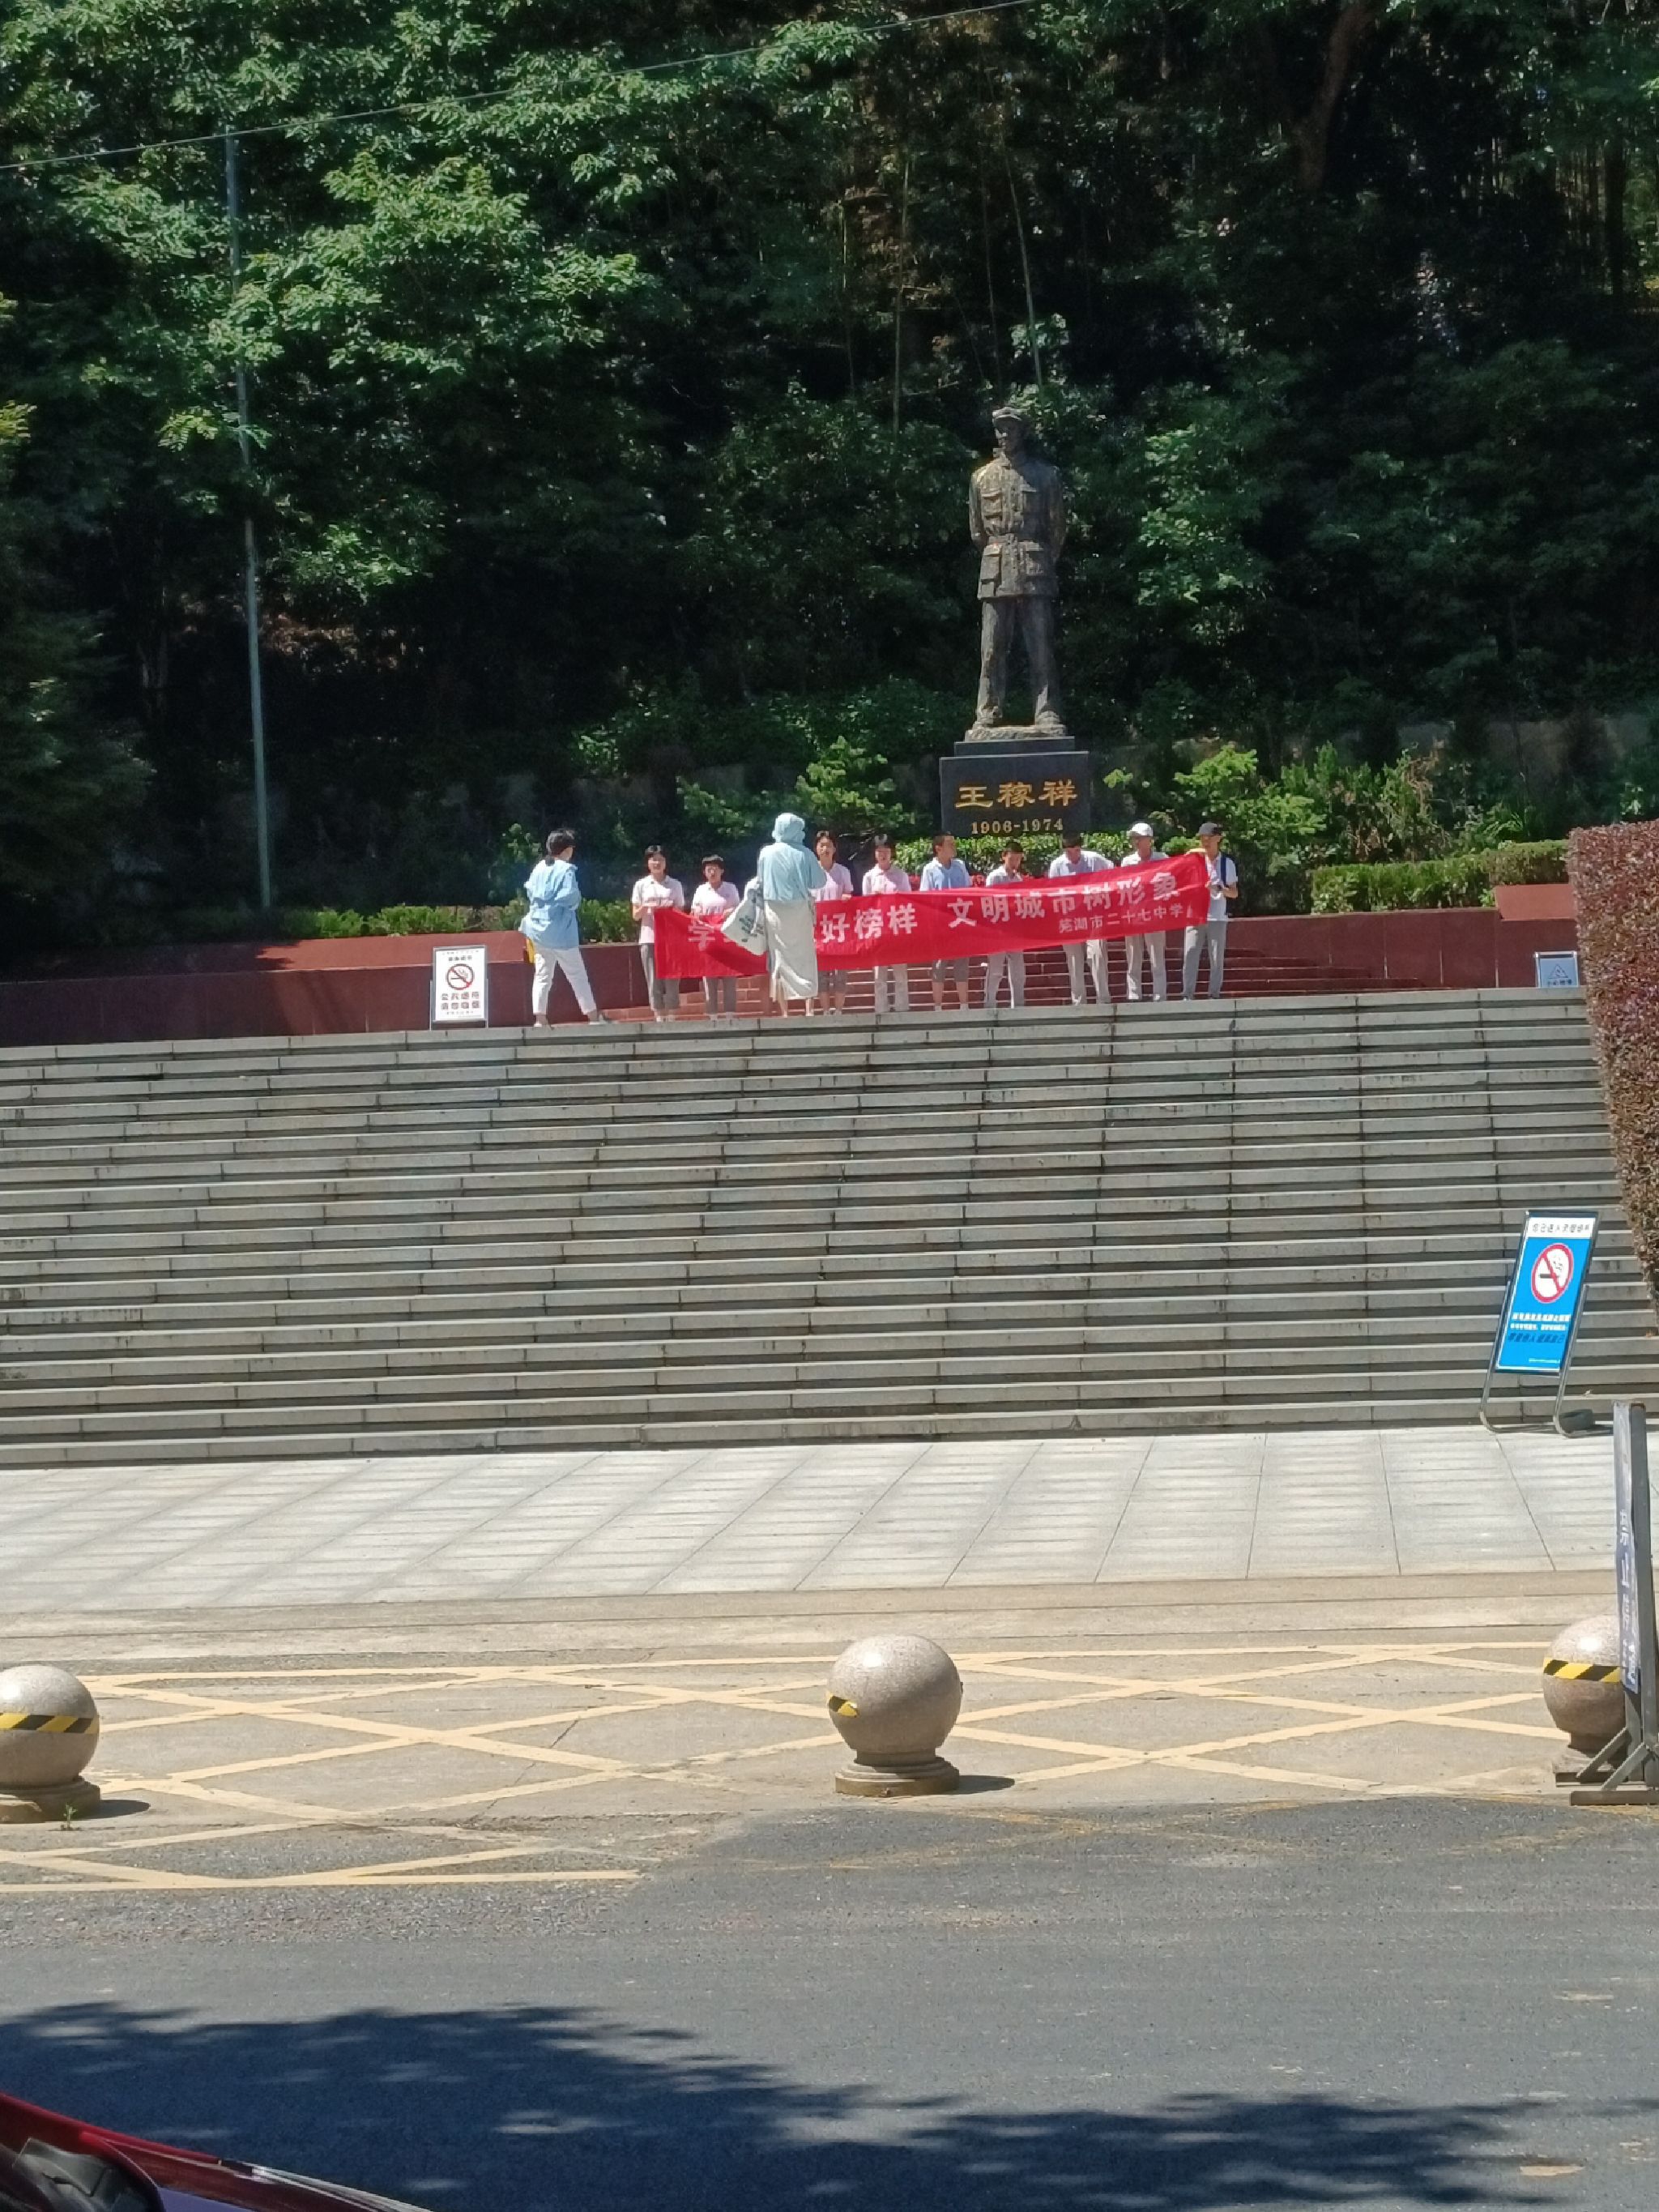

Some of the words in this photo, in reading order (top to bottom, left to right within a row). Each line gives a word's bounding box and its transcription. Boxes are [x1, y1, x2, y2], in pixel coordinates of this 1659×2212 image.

[954, 778, 1078, 809] 王稼祥
[971, 818, 1064, 835] 1906-1974
[947, 871, 1179, 929] 文明城市树形象
